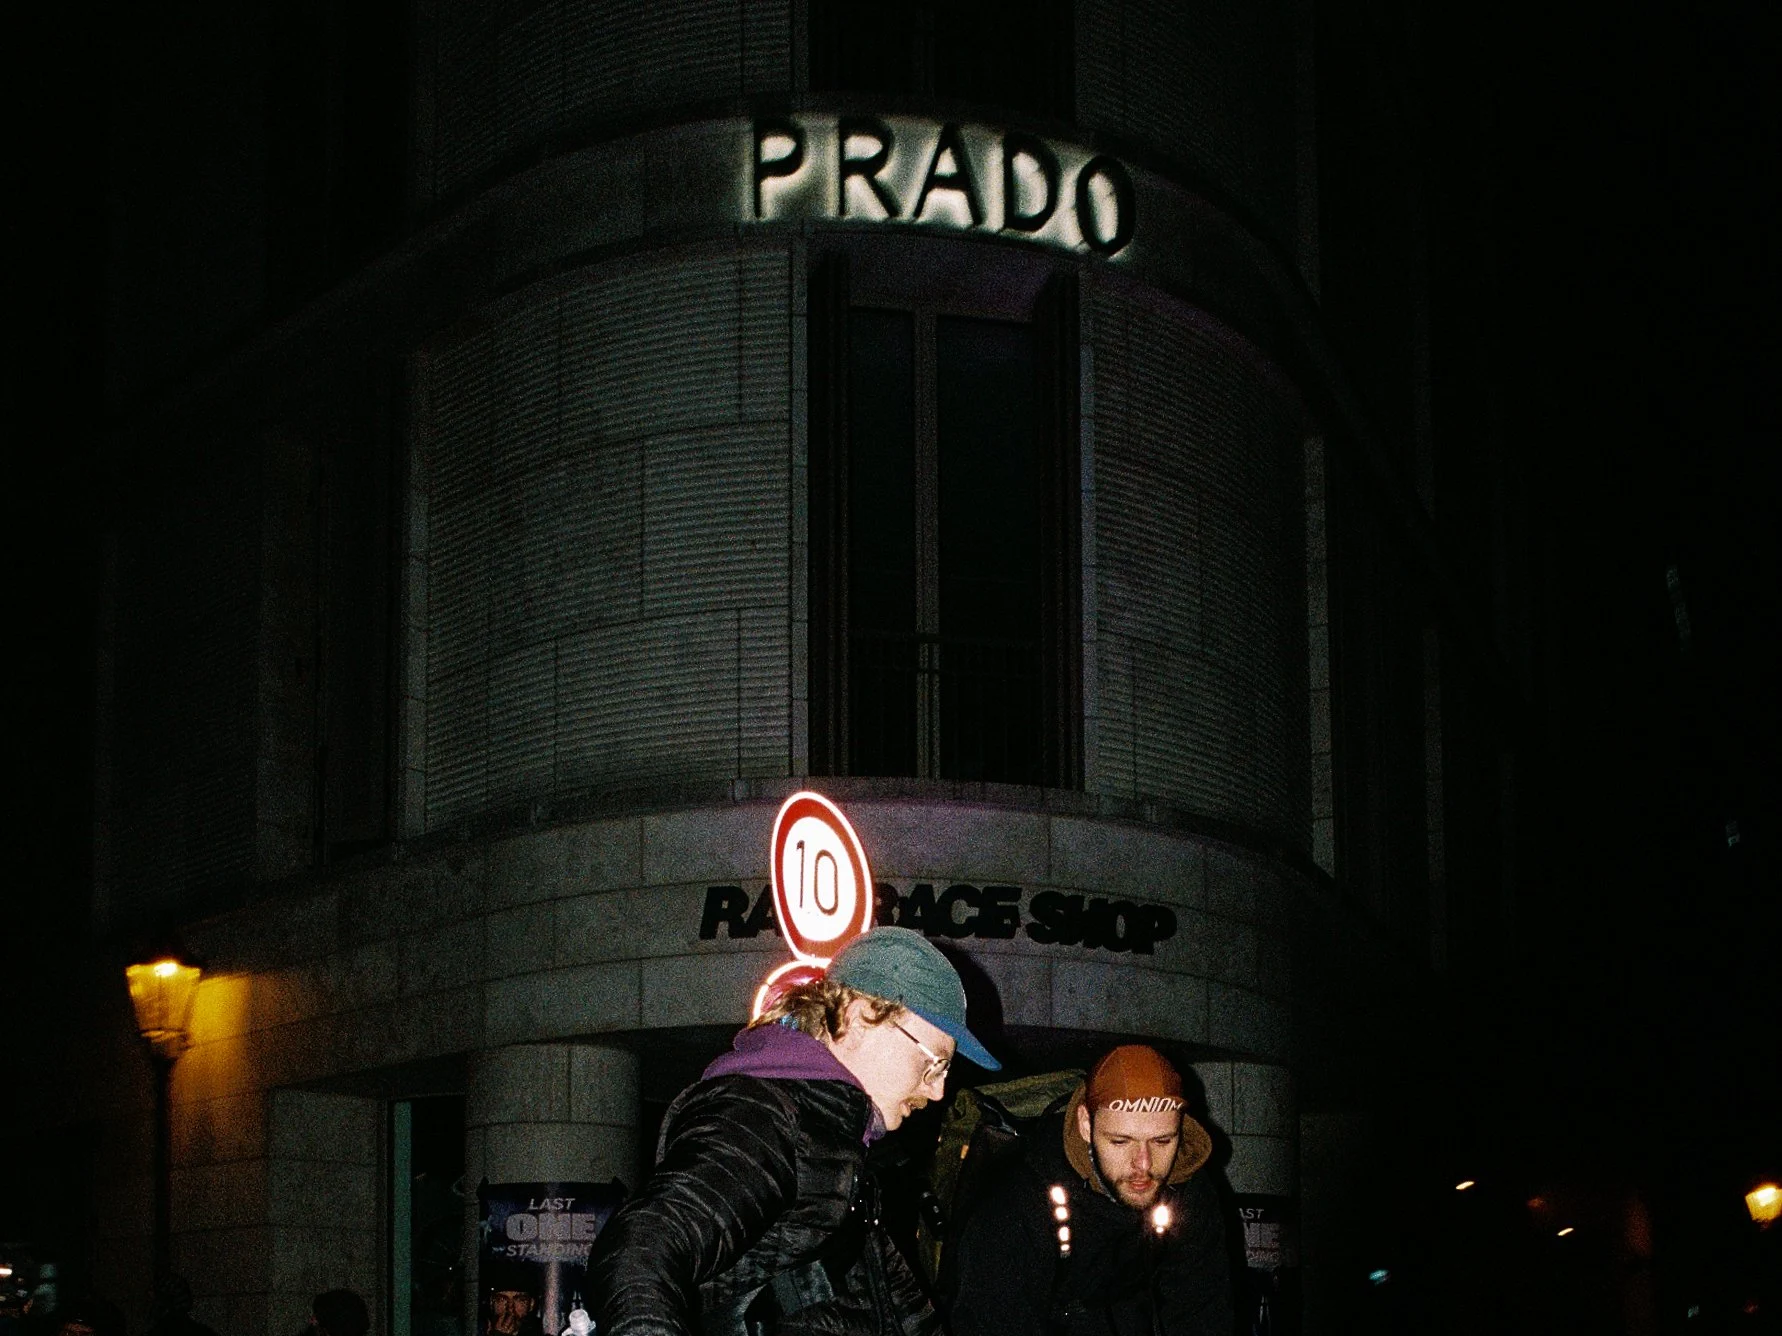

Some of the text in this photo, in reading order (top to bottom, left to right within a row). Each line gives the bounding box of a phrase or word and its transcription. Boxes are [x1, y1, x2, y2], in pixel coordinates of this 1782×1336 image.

[754, 118, 1136, 257] PRADO
[796, 840, 838, 916] 10
[700, 884, 1178, 955] RA RACE SHOP
[506, 1213, 597, 1242] ONE
[529, 1198, 575, 1210] LAST
